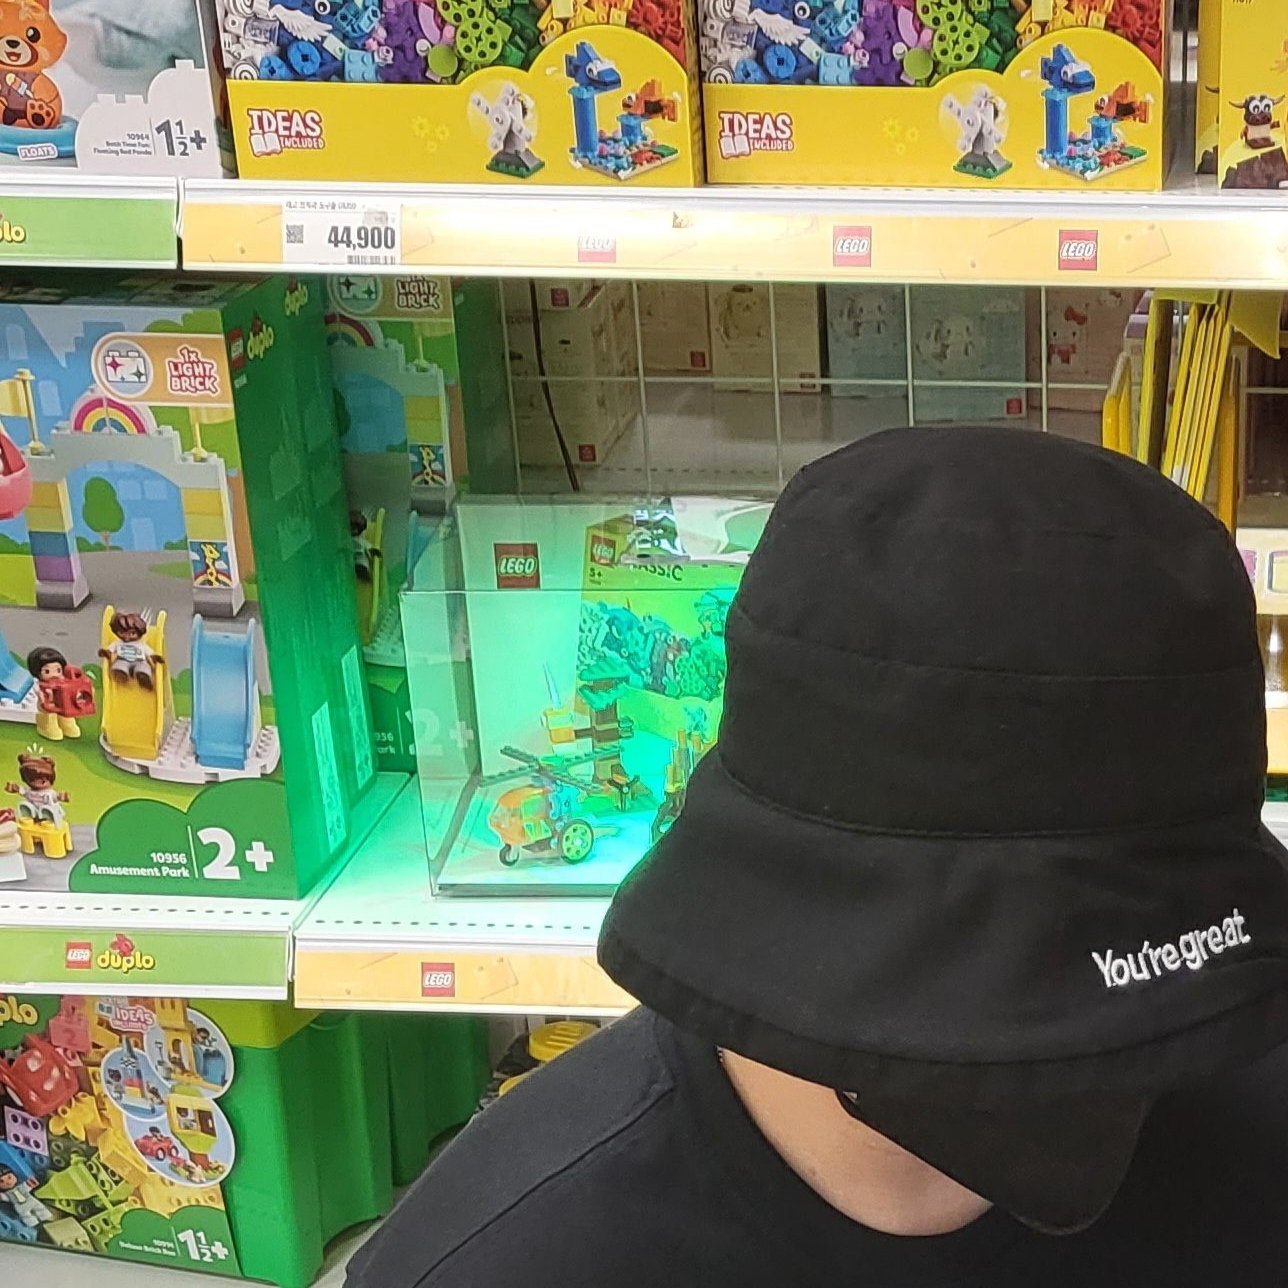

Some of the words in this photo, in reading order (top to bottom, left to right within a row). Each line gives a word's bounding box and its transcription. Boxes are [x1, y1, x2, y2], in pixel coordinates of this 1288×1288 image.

[247, 108, 323, 138] IDEAS
[719, 112, 793, 140] IDEAS
[279, 137, 325, 150] INCLUDED
[749, 138, 795, 151] INCLUDED
[328, 225, 396, 251] 44,900
[836, 238, 869, 254] LEGO
[1060, 239, 1096, 260] LEGO
[397, 280, 437, 297] LIGHT
[397, 293, 440, 310] BRICK
[180, 347, 200, 363] 1x
[168, 361, 216, 379] LIGHT
[170, 374, 218, 394] BRICK
[498, 555, 539, 577] LEGO
[150, 852, 188, 865] 10956
[196, 826, 275, 881] 2+
[90, 863, 161, 877] Amusement
[162, 866, 190, 878] Park
[1090, 940, 1182, 988] You're
[1179, 907, 1252, 970] great
[97, 951, 155, 973] duplo
[422, 972, 454, 988] LEGO
[114, 1007, 154, 1024] IDEAS
